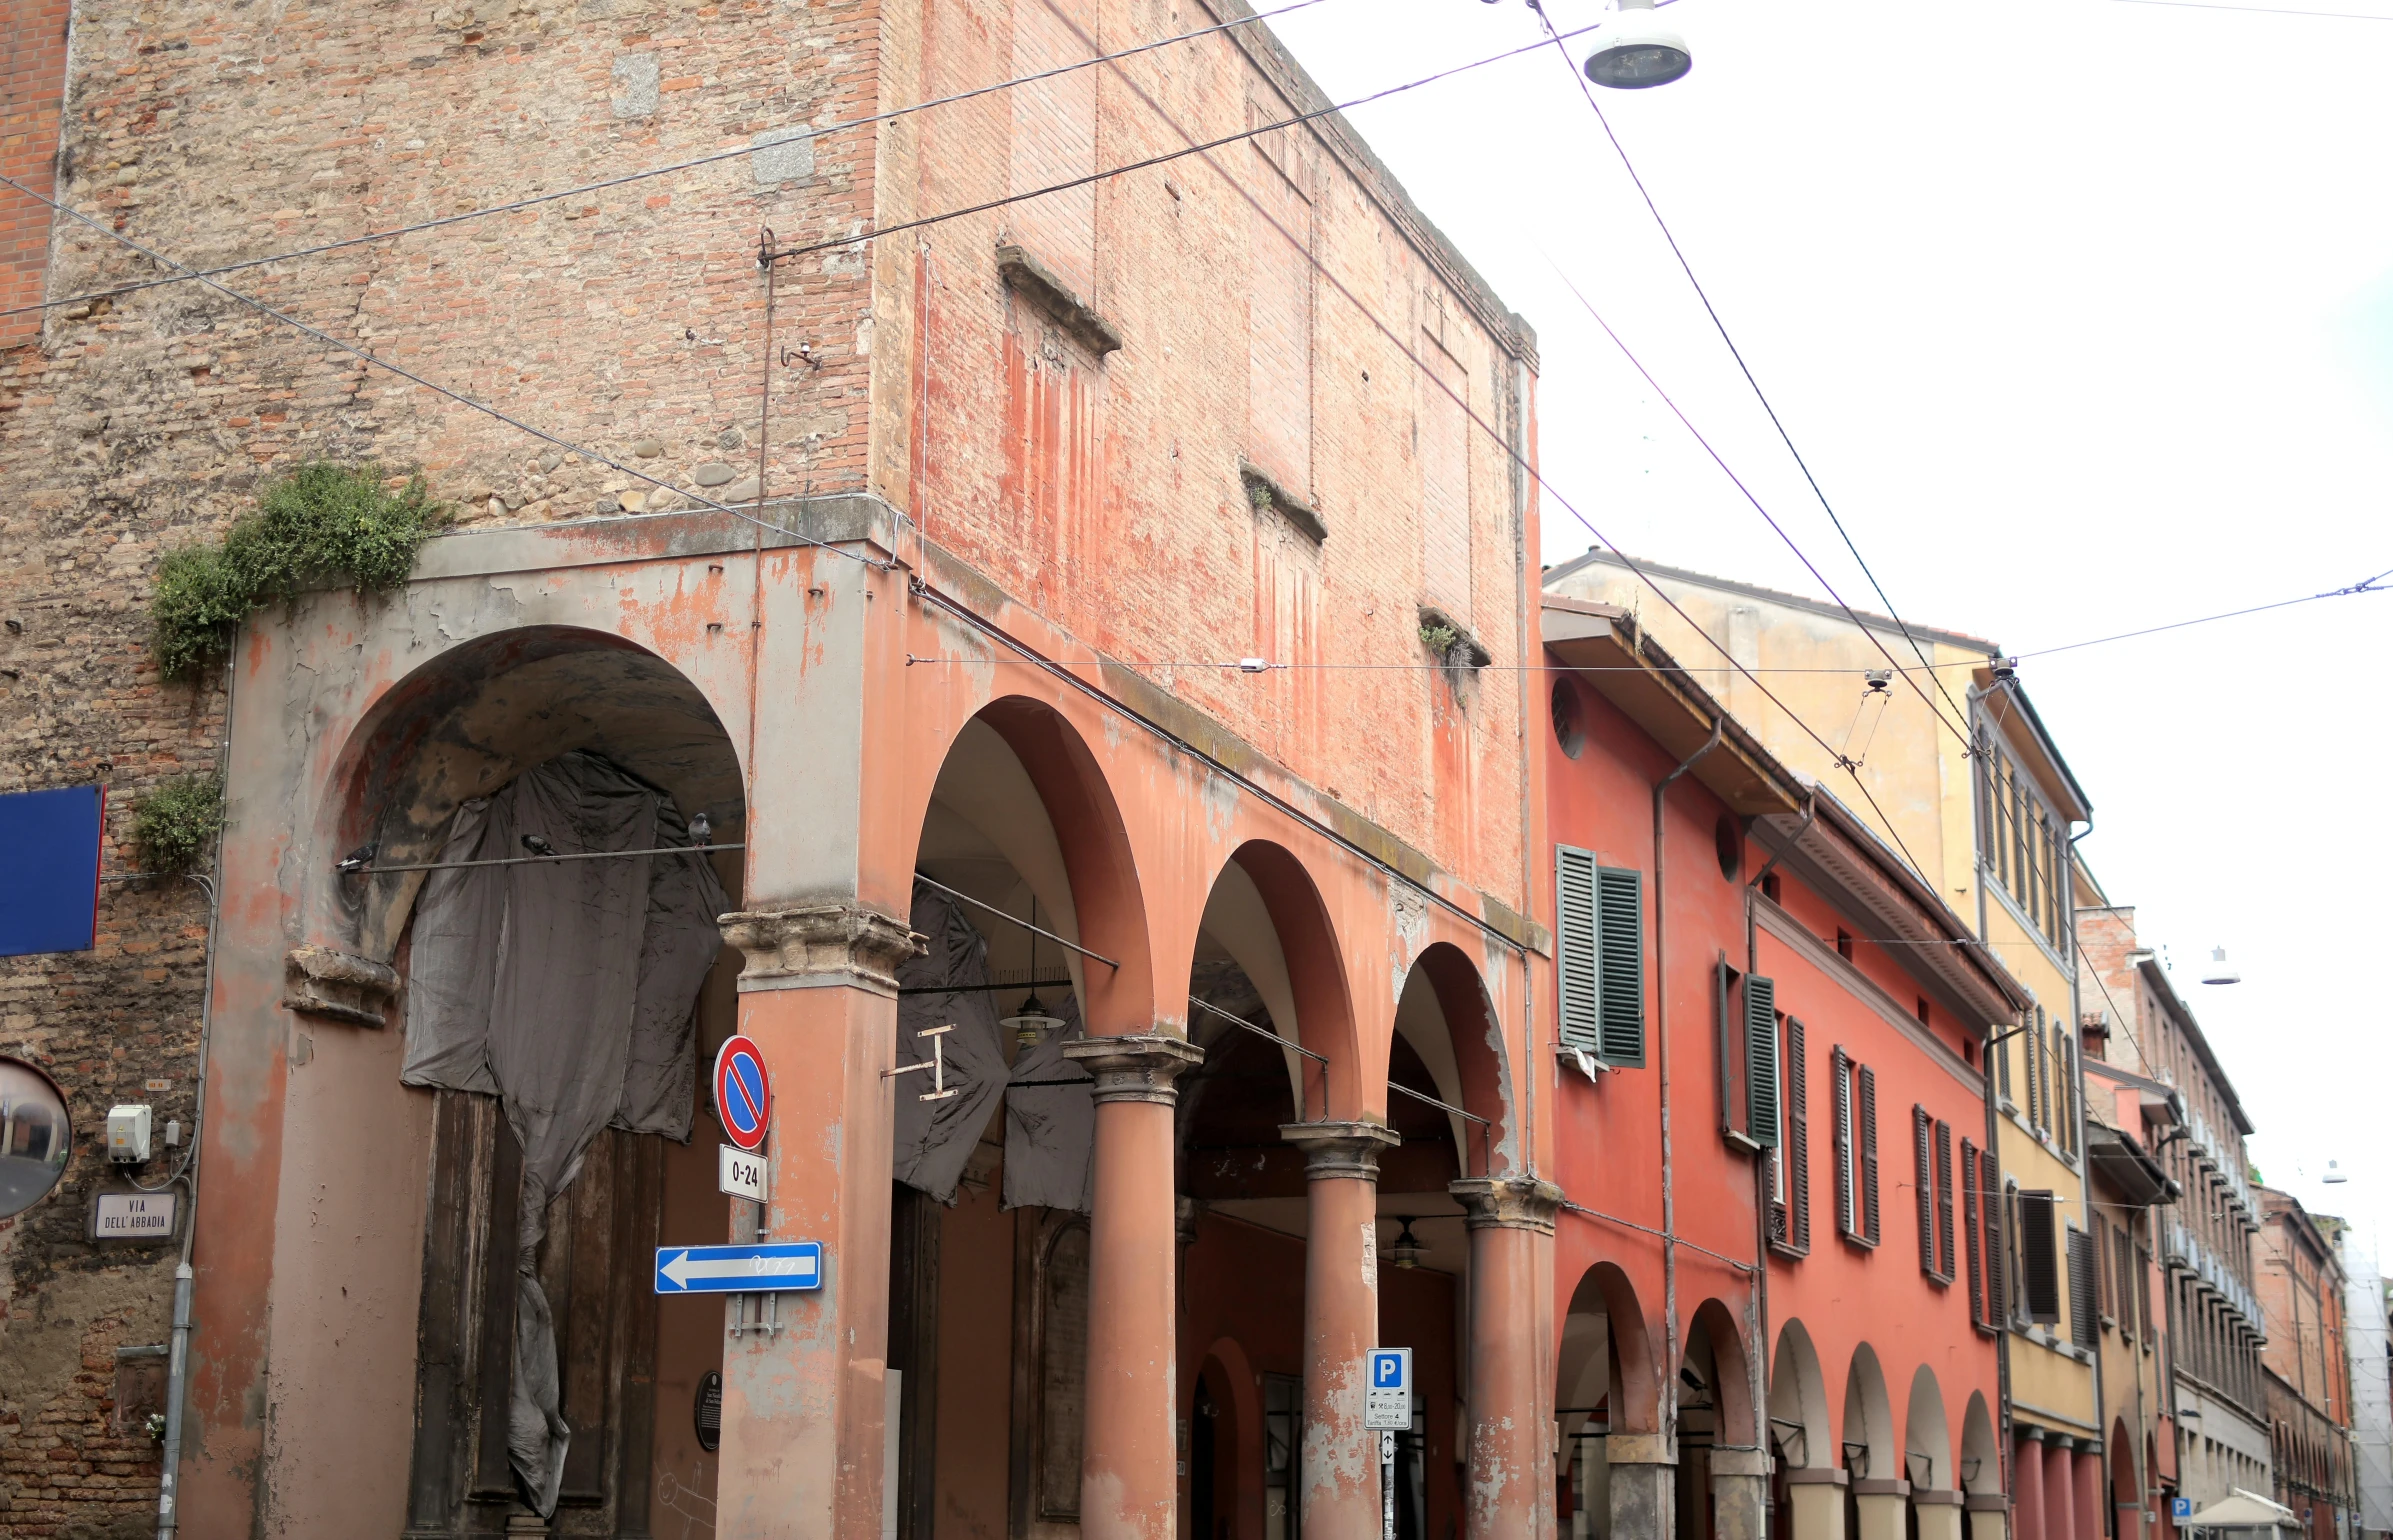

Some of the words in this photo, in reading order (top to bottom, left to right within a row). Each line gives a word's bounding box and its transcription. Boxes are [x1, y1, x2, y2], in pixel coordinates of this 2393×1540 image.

[732, 1161, 758, 1187] 0-24
[129, 1199, 145, 1212] VIA
[105, 1216, 129, 1228] DELL'
[130, 1215, 165, 1228] ABBADIA
[1380, 1359, 1396, 1382] P
[2174, 1500, 2187, 1515] P
